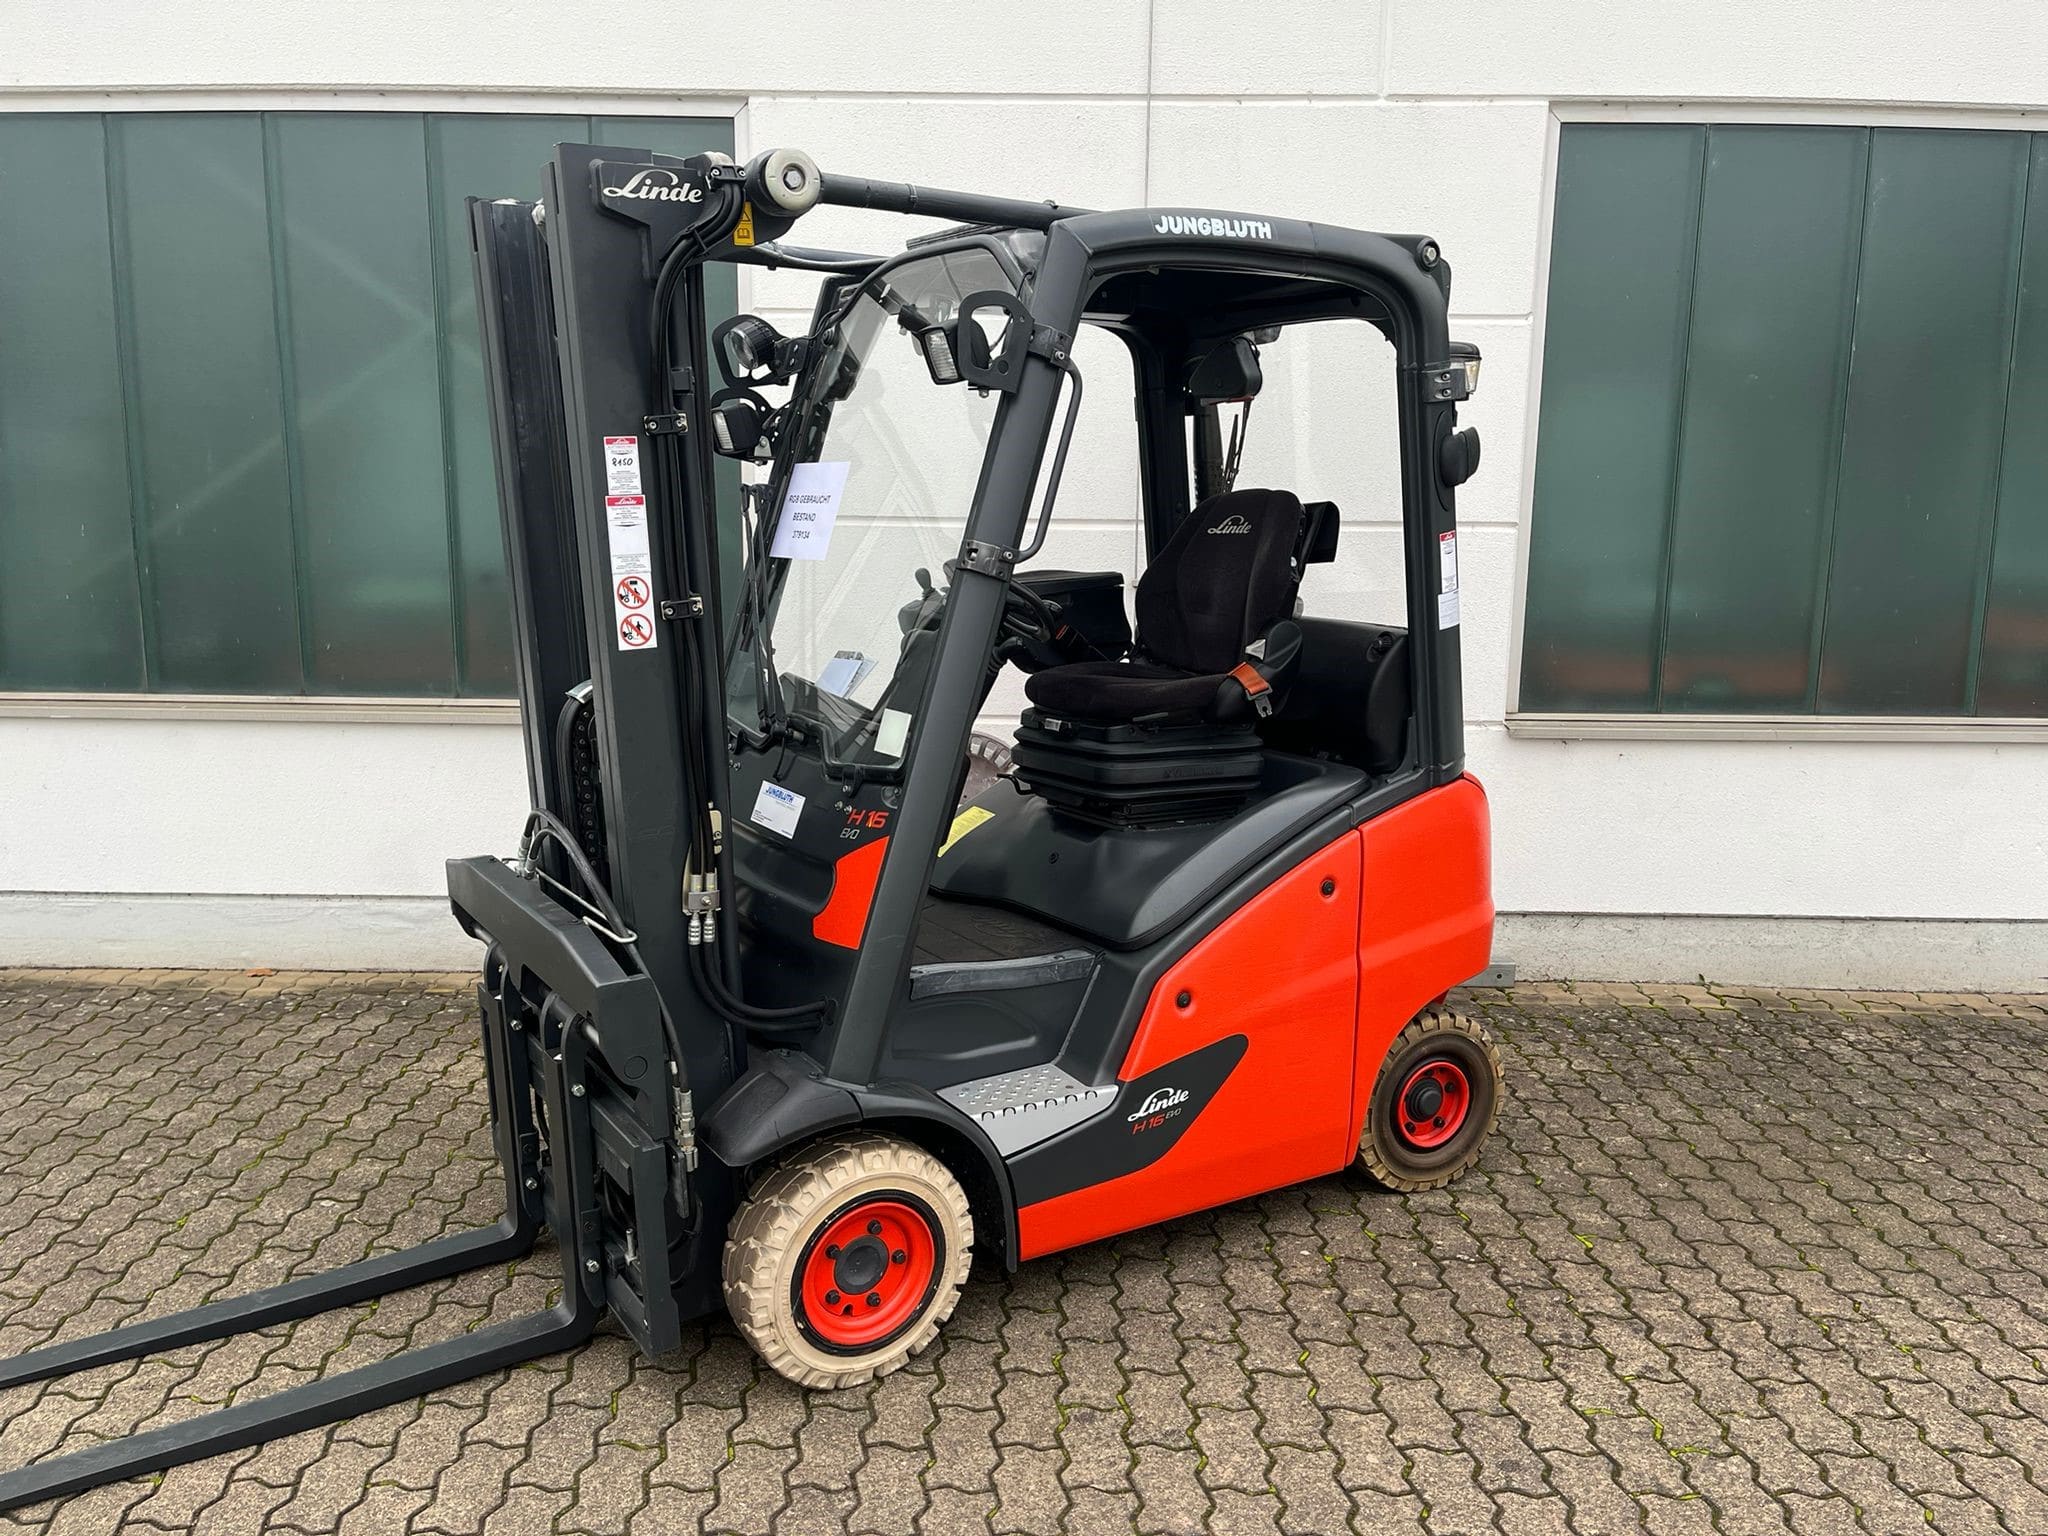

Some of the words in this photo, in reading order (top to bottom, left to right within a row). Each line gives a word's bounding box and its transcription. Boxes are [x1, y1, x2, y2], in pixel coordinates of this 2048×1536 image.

[602, 168, 704, 204] Linde
[1154, 215, 1273, 240] JUNGBLUTH
[792, 512, 817, 522] BESTAND
[1207, 514, 1252, 535] Linde
[765, 786, 795, 804] JUNGBLUTH
[847, 808, 866, 826] H
[866, 810, 890, 829] 16
[1127, 1087, 1190, 1122] Linde
[1132, 1119, 1147, 1136] H
[1148, 1113, 1166, 1130] 16
